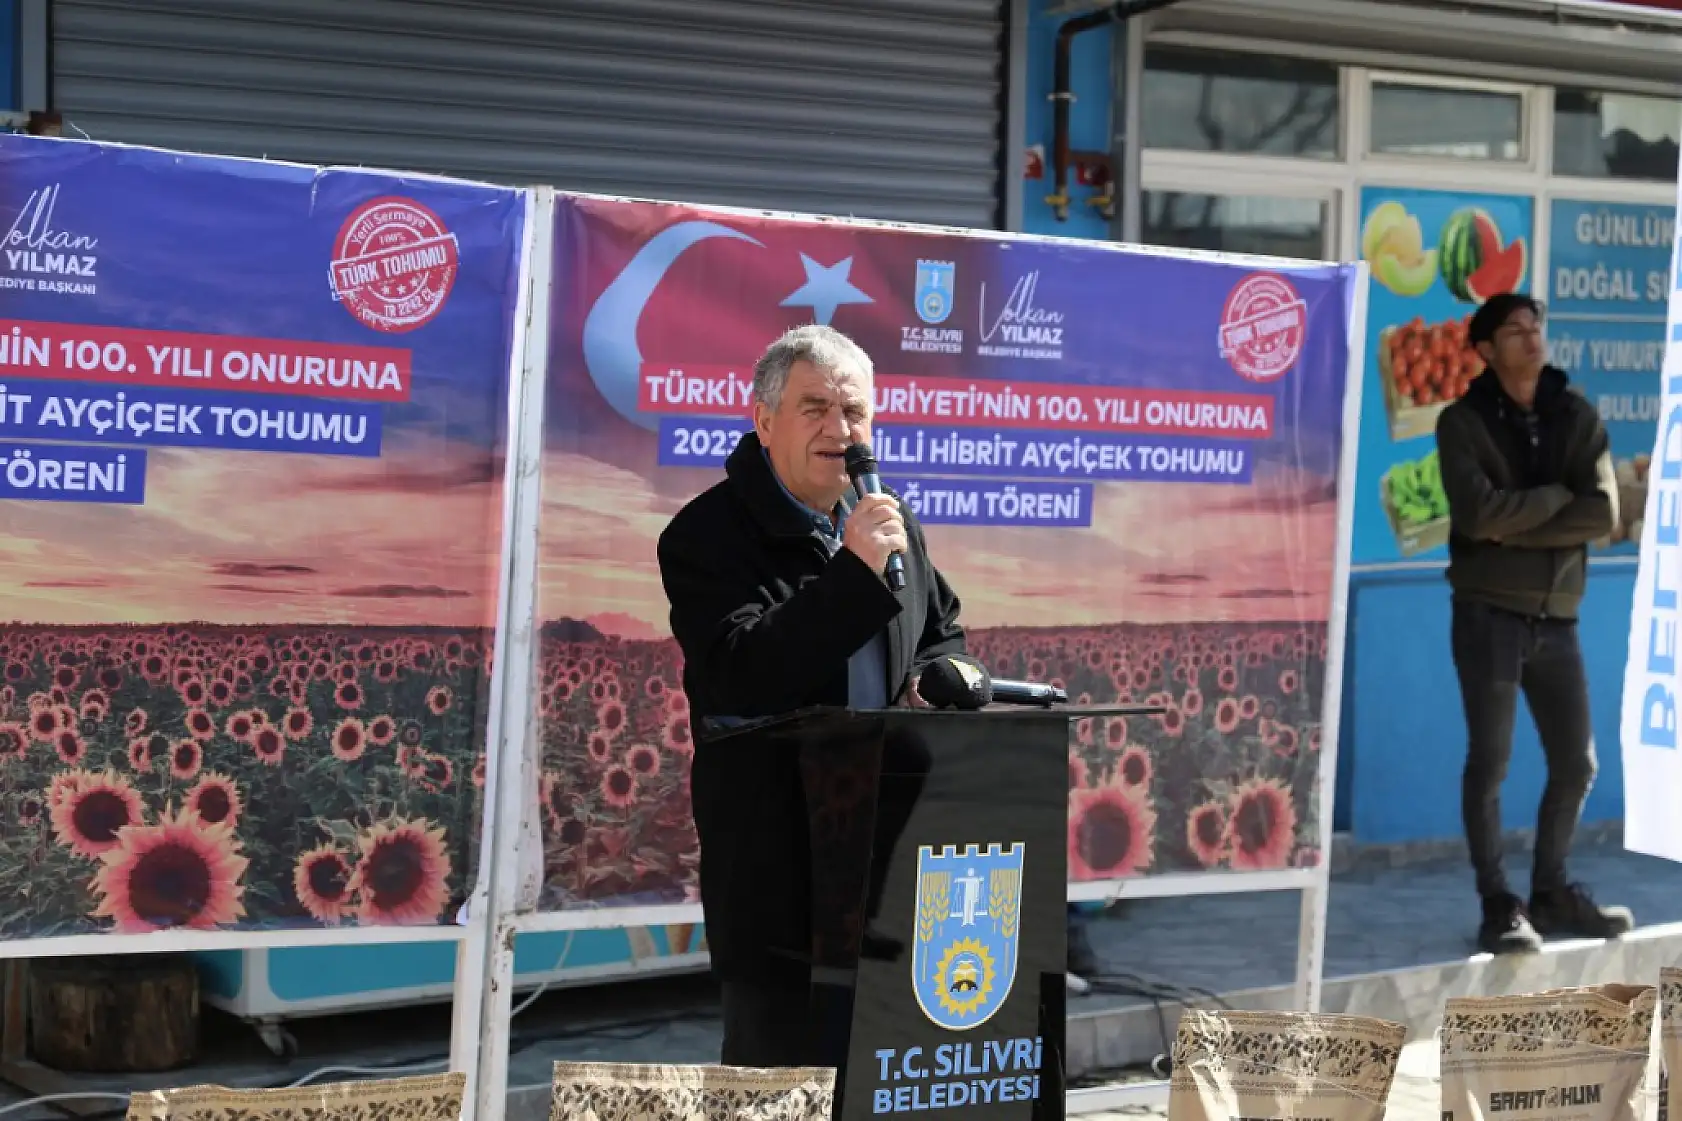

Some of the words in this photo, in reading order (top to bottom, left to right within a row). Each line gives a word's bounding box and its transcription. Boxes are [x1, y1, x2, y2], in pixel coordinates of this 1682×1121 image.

[6, 250, 97, 277] YILMAZ
[380, 244, 448, 277] TOHUMU
[1555, 261, 1640, 301] DOĞAL
[1001, 325, 1064, 345] YILMAZ
[60, 339, 137, 374] 100.
[145, 344, 213, 379] YILI
[221, 350, 402, 391] ONURUNA
[37, 392, 202, 437] AYÇİÇEK
[210, 406, 368, 444] TOHUMU
[645, 369, 754, 406] TÜRKİY
[1036, 396, 1088, 421] 100.
[1094, 398, 1140, 424] YILI
[1145, 400, 1268, 430] ONURUNA
[929, 430, 1018, 467] HİBRİT
[1021, 436, 1132, 474] AYÇİÇEK
[1138, 447, 1244, 475] TOHUMU
[898, 481, 979, 517] ĞITIM
[984, 485, 1080, 519] TÖRENİ
[875, 1046, 929, 1081] T.C.
